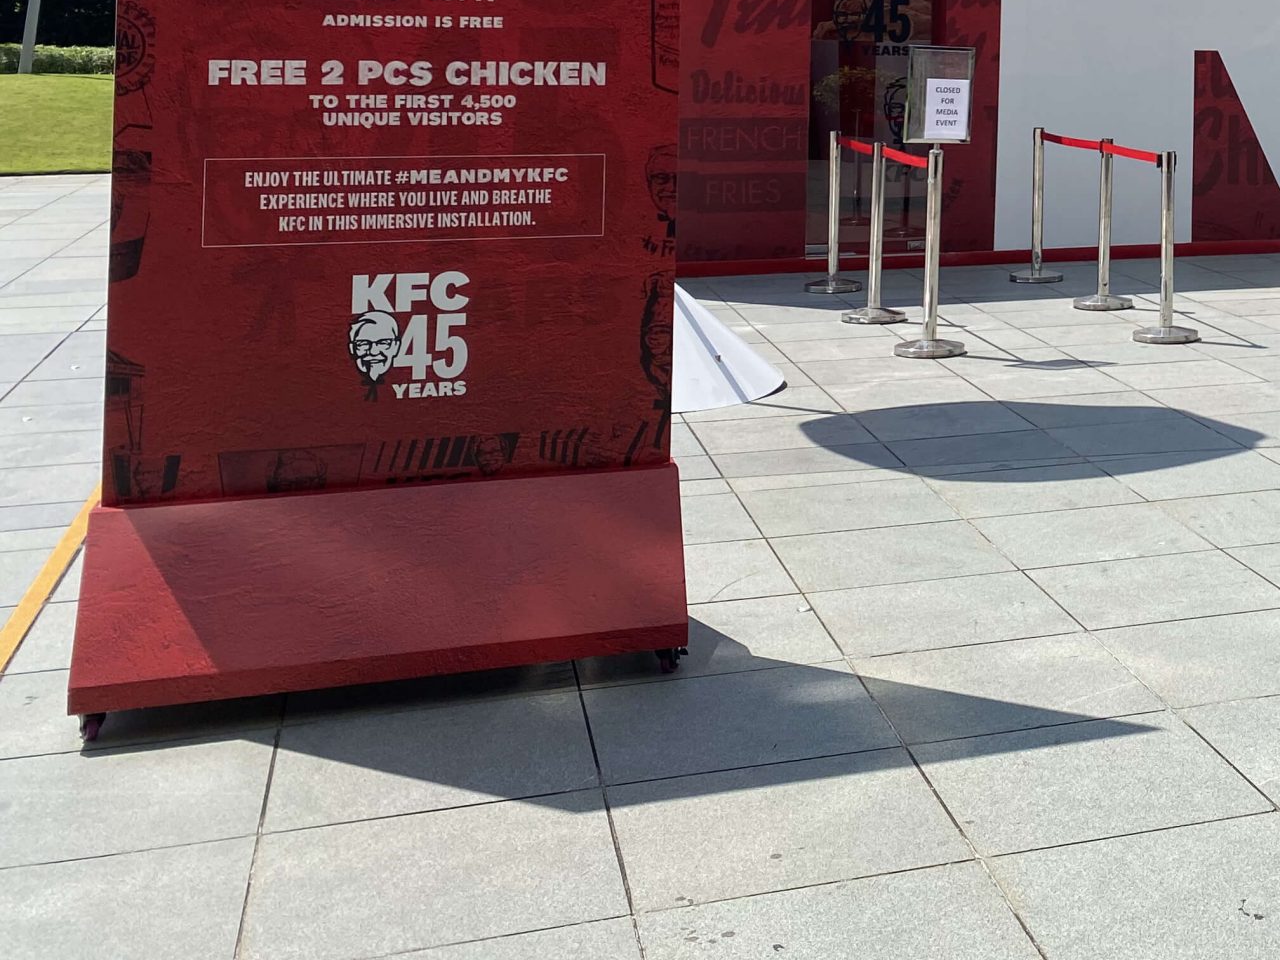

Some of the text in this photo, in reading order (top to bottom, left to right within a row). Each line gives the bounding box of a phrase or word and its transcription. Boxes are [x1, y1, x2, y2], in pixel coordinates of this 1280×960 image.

[323, 15, 503, 28] ADMISSION IS FREE
[209, 60, 605, 86] FREE 2 PCS CHICKEN
[935, 86, 961, 94] CLOSED
[309, 95, 516, 109] TO THE FIRST 4,500
[941, 97, 955, 105] FOR
[323, 112, 502, 128] UNIQUE VISITORS
[935, 108, 959, 116] MEDIA
[935, 119, 958, 127] EVENT
[686, 124, 803, 152] FRENCH
[245, 168, 568, 187] ENJOY THE ULTIMATE #MEANDMYKFC
[260, 189, 551, 209] EXPERIENCE WHERE YOU LIVE AND BREATHE
[705, 178, 782, 205] FRIES
[279, 211, 535, 231] KFC IN THIS IMMERSIVE INSTALLATION.
[351, 271, 470, 314] KFC
[392, 313, 468, 380] 45
[392, 381, 466, 398] YEARS
